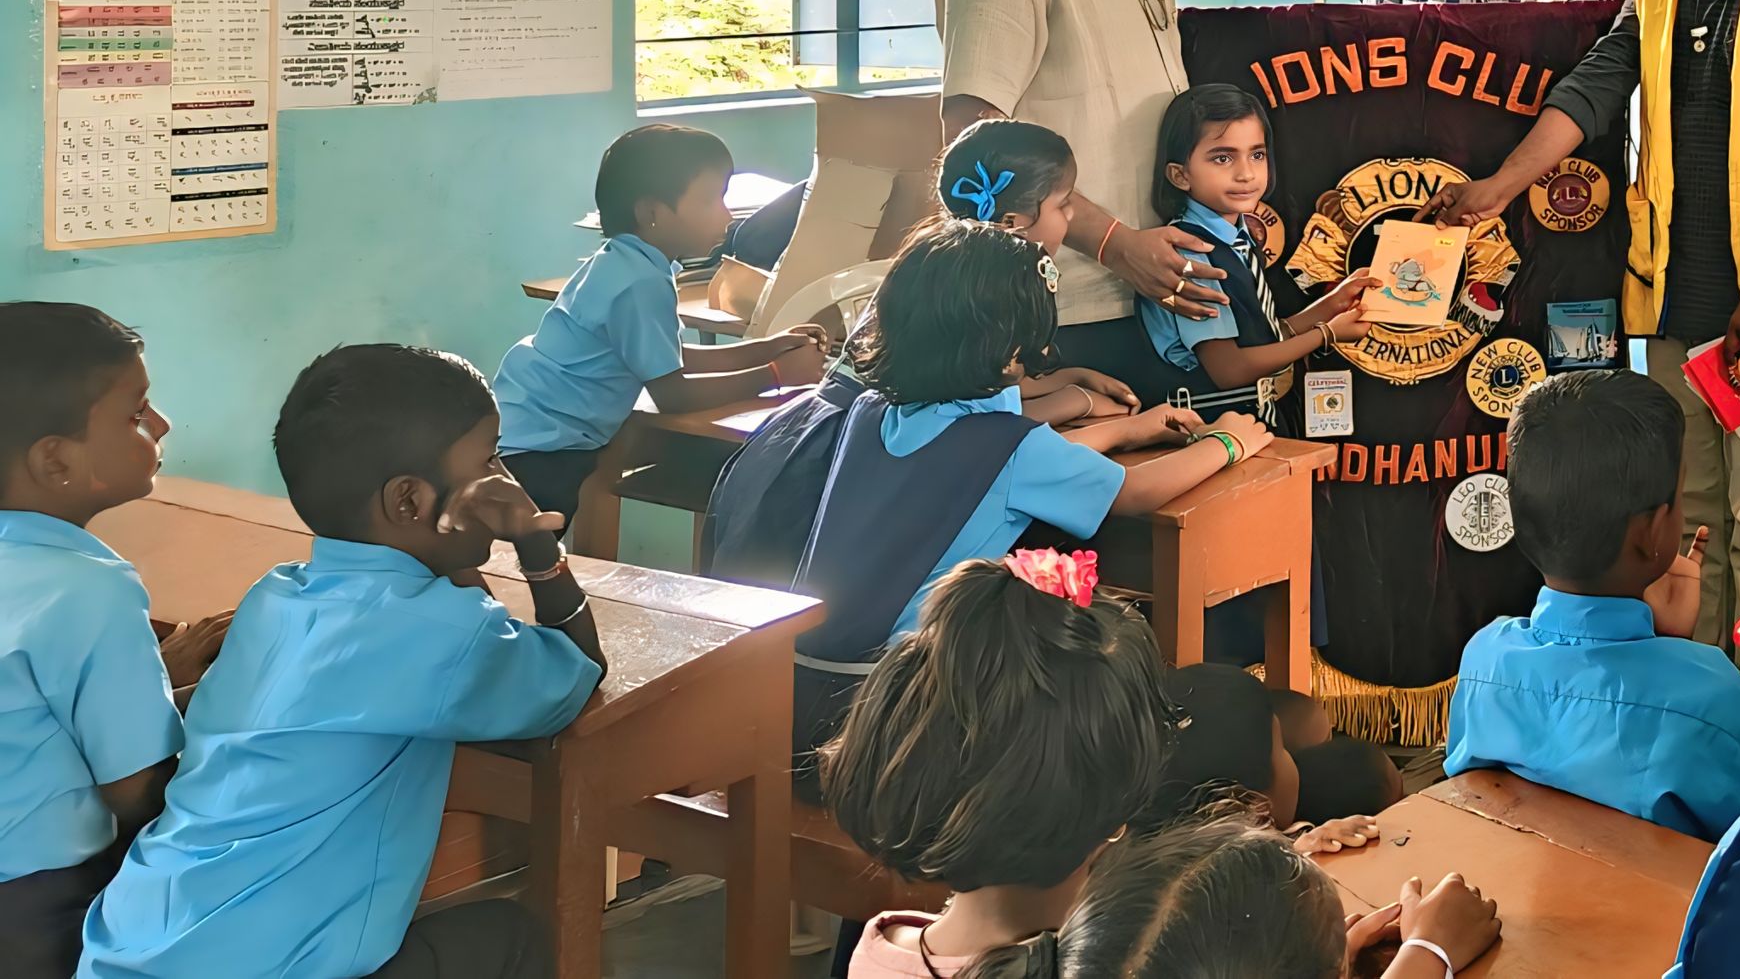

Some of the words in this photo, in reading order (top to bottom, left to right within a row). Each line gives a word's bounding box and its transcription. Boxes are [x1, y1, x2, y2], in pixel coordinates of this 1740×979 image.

[1250, 37, 1408, 109] IONS
[1427, 41, 1553, 116] CLU
[1568, 160, 1602, 185] CLUB
[1350, 170, 1442, 212] LION
[1253, 200, 1278, 227] LUB
[1540, 203, 1604, 231] SPONSOR
[1470, 344, 1499, 380] NEW
[1507, 341, 1542, 373] CLUB
[1500, 368, 1513, 384] L
[1472, 386, 1514, 414] SPON
[1452, 482, 1475, 504] LEO
[1455, 522, 1514, 548] SPONSOR
